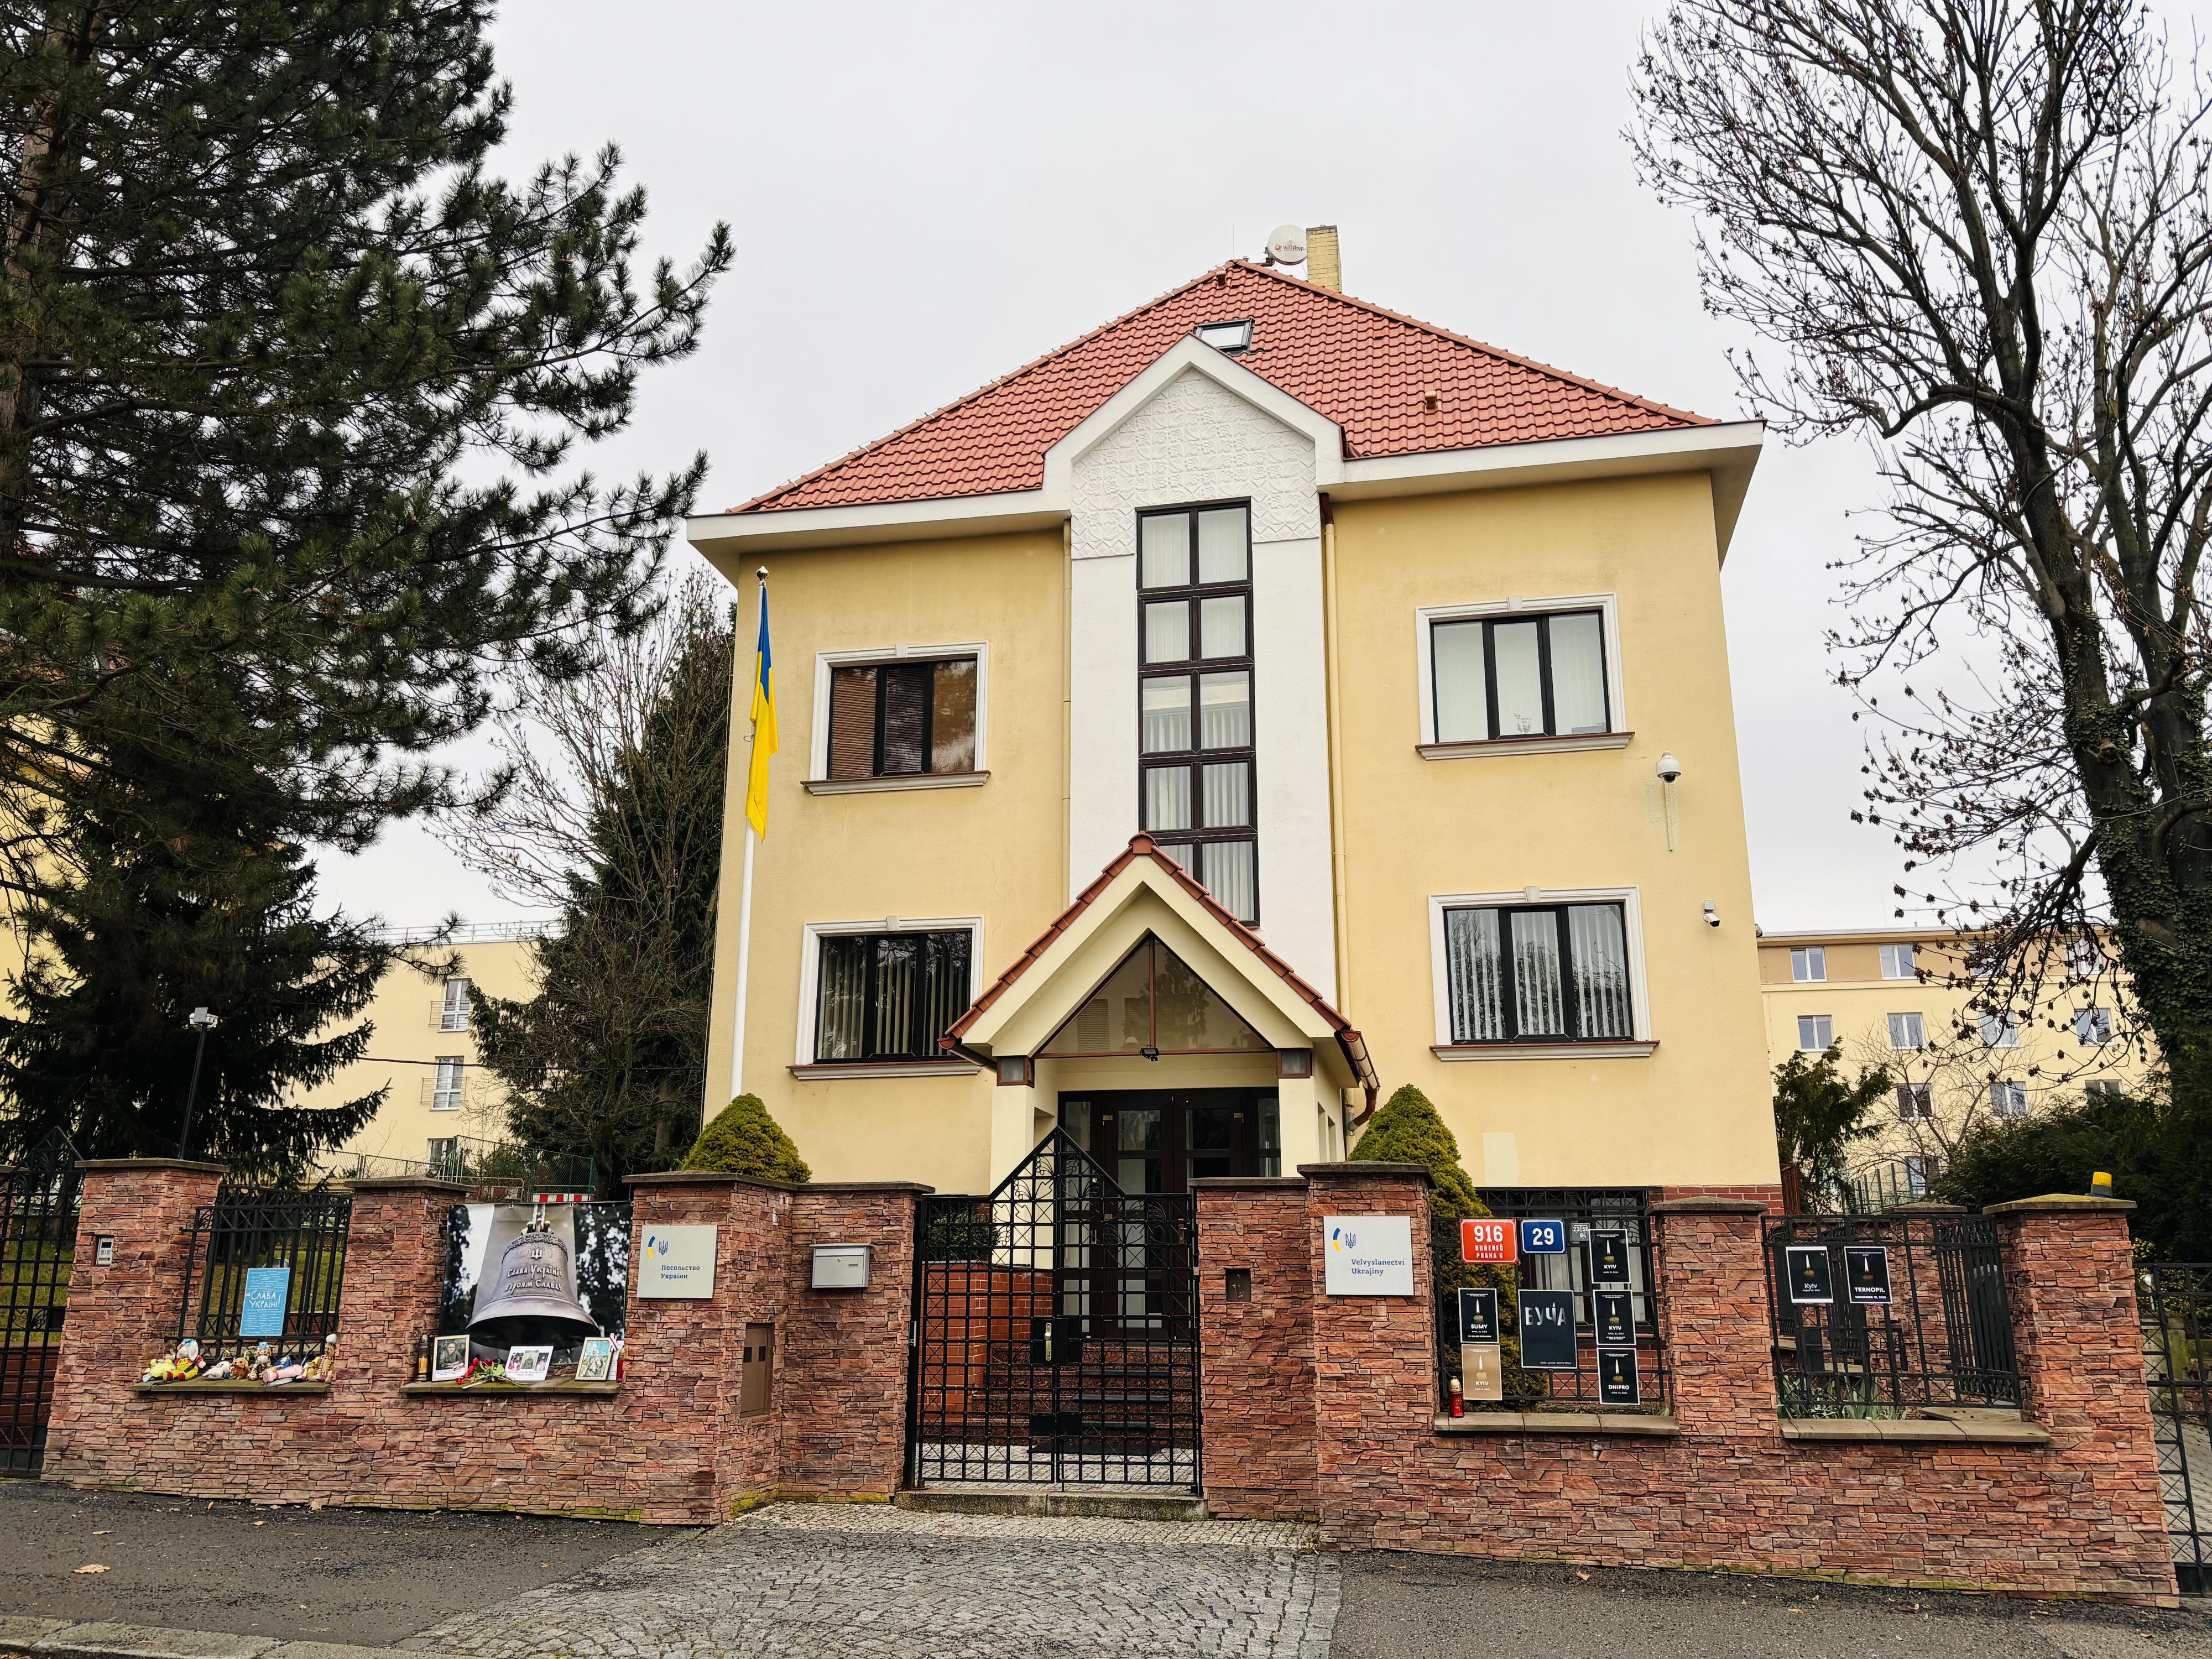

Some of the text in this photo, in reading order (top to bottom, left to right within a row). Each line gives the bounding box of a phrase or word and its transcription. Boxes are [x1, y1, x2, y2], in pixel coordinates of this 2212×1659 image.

[1474, 1225, 1503, 1243] 916
[1532, 1228, 1554, 1245] 29
[1351, 1258, 1405, 1267] Velvyslanectví
[508, 1267, 528, 1278] Слава
[1351, 1267, 1384, 1276] Ukrajiny
[1525, 1302, 1567, 1326] БУЧА
